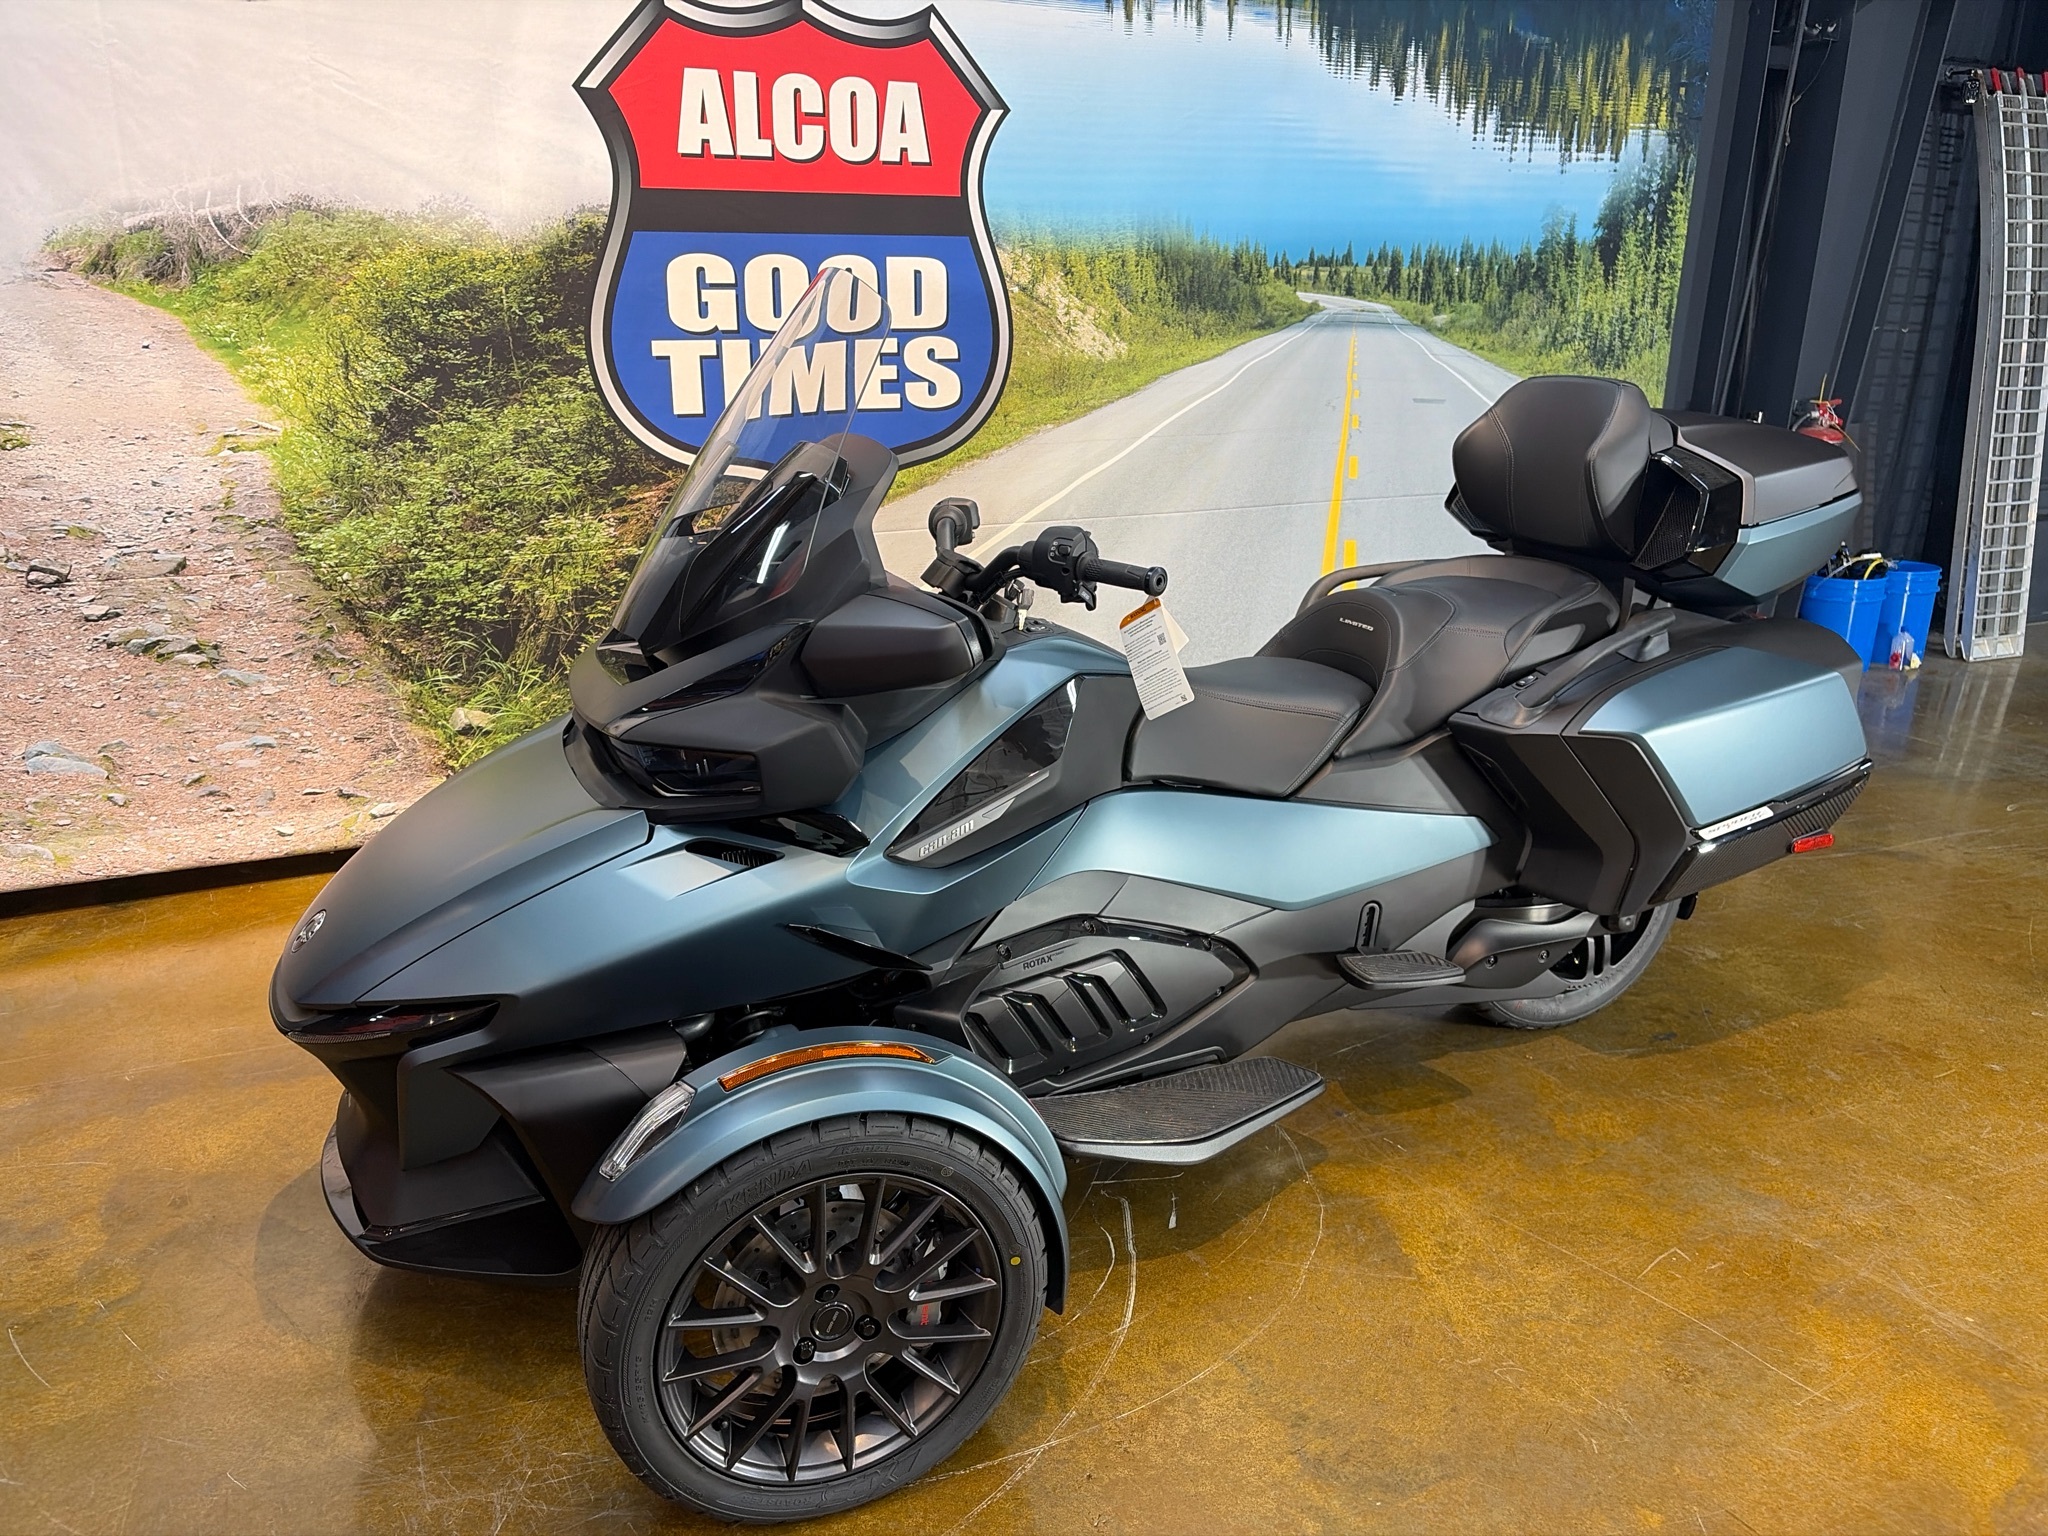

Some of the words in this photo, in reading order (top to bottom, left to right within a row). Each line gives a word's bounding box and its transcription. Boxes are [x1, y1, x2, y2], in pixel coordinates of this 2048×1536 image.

[677, 67, 931, 164] ALCOA
[666, 252, 948, 335] GOOD
[651, 336, 962, 420] TIMES
[1022, 955, 1053, 970] ROTAX
[723, 1158, 813, 1218] KENDA
